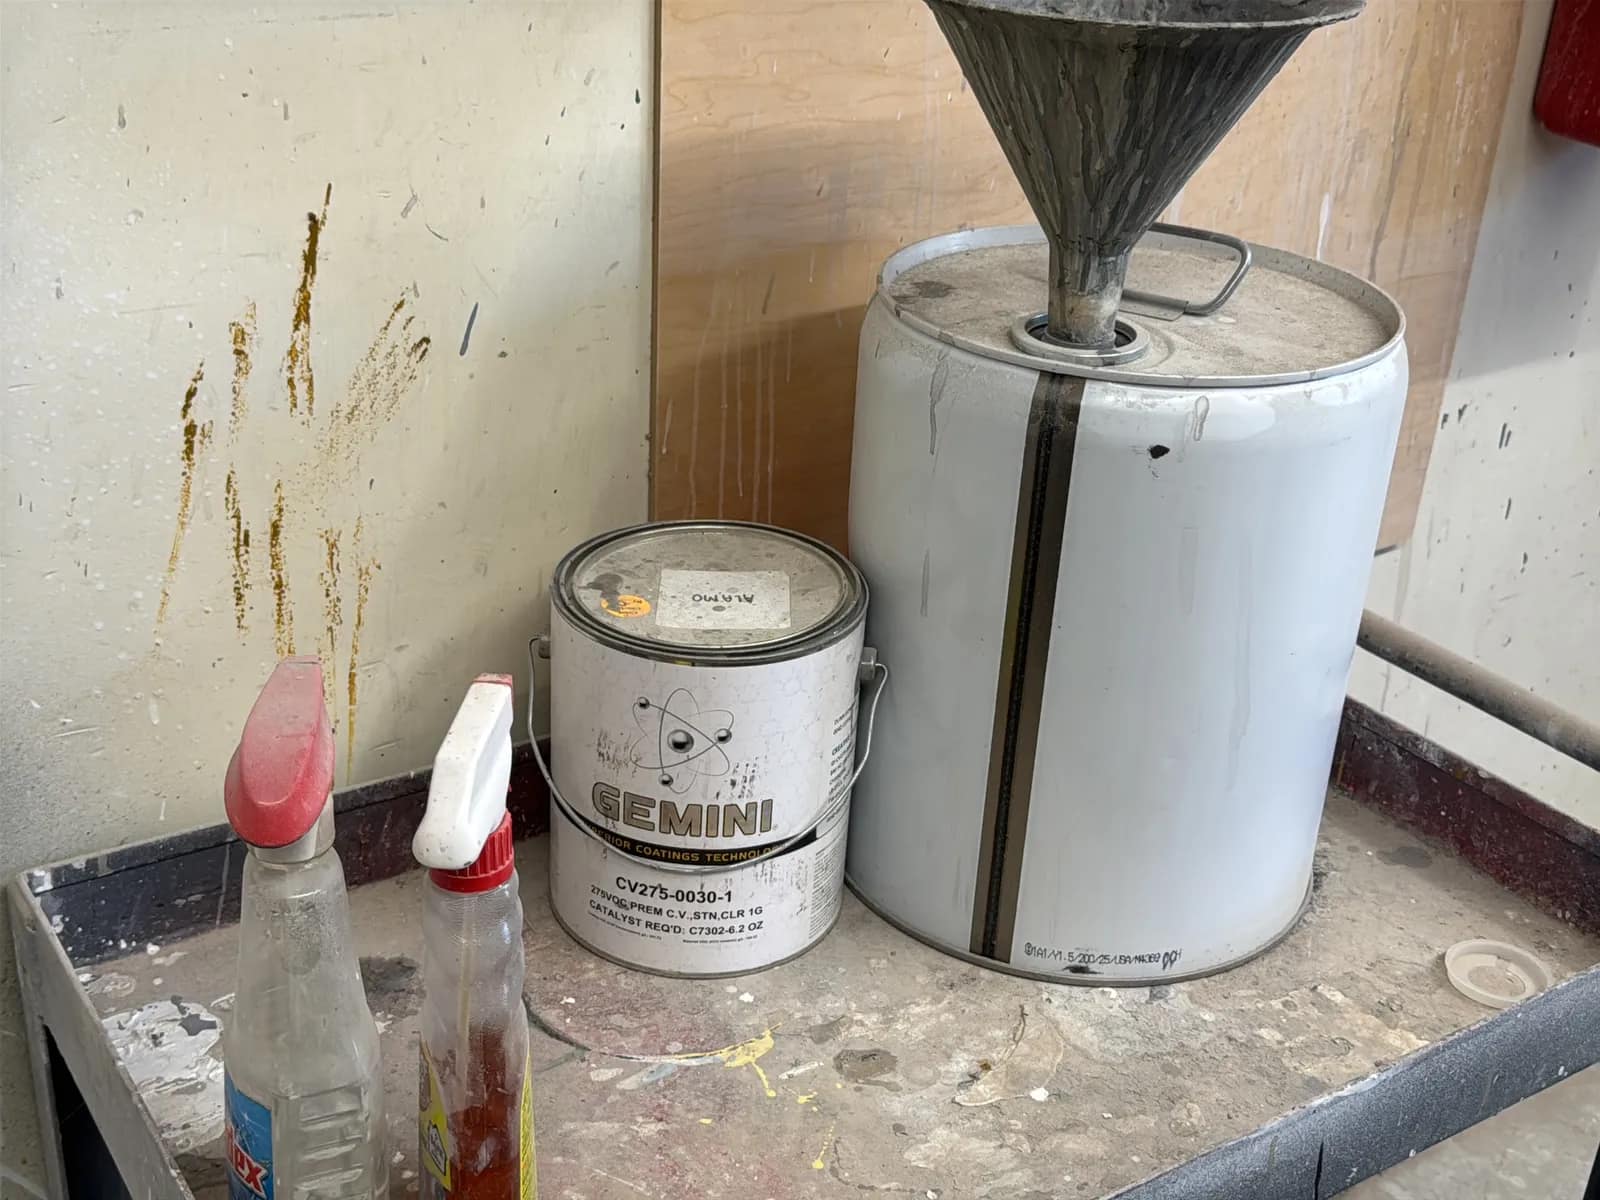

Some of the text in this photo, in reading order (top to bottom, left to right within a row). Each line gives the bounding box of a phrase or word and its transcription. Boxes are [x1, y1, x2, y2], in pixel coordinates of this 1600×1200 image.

[691, 593, 755, 603] ALAMO
[592, 781, 773, 838] GEMINI
[635, 845, 700, 863] COATINGS
[615, 876, 732, 903] CV275-0030-1
[589, 899, 642, 928] CATALYST
[747, 920, 764, 932] OZ
[748, 906, 764, 917] 1G
